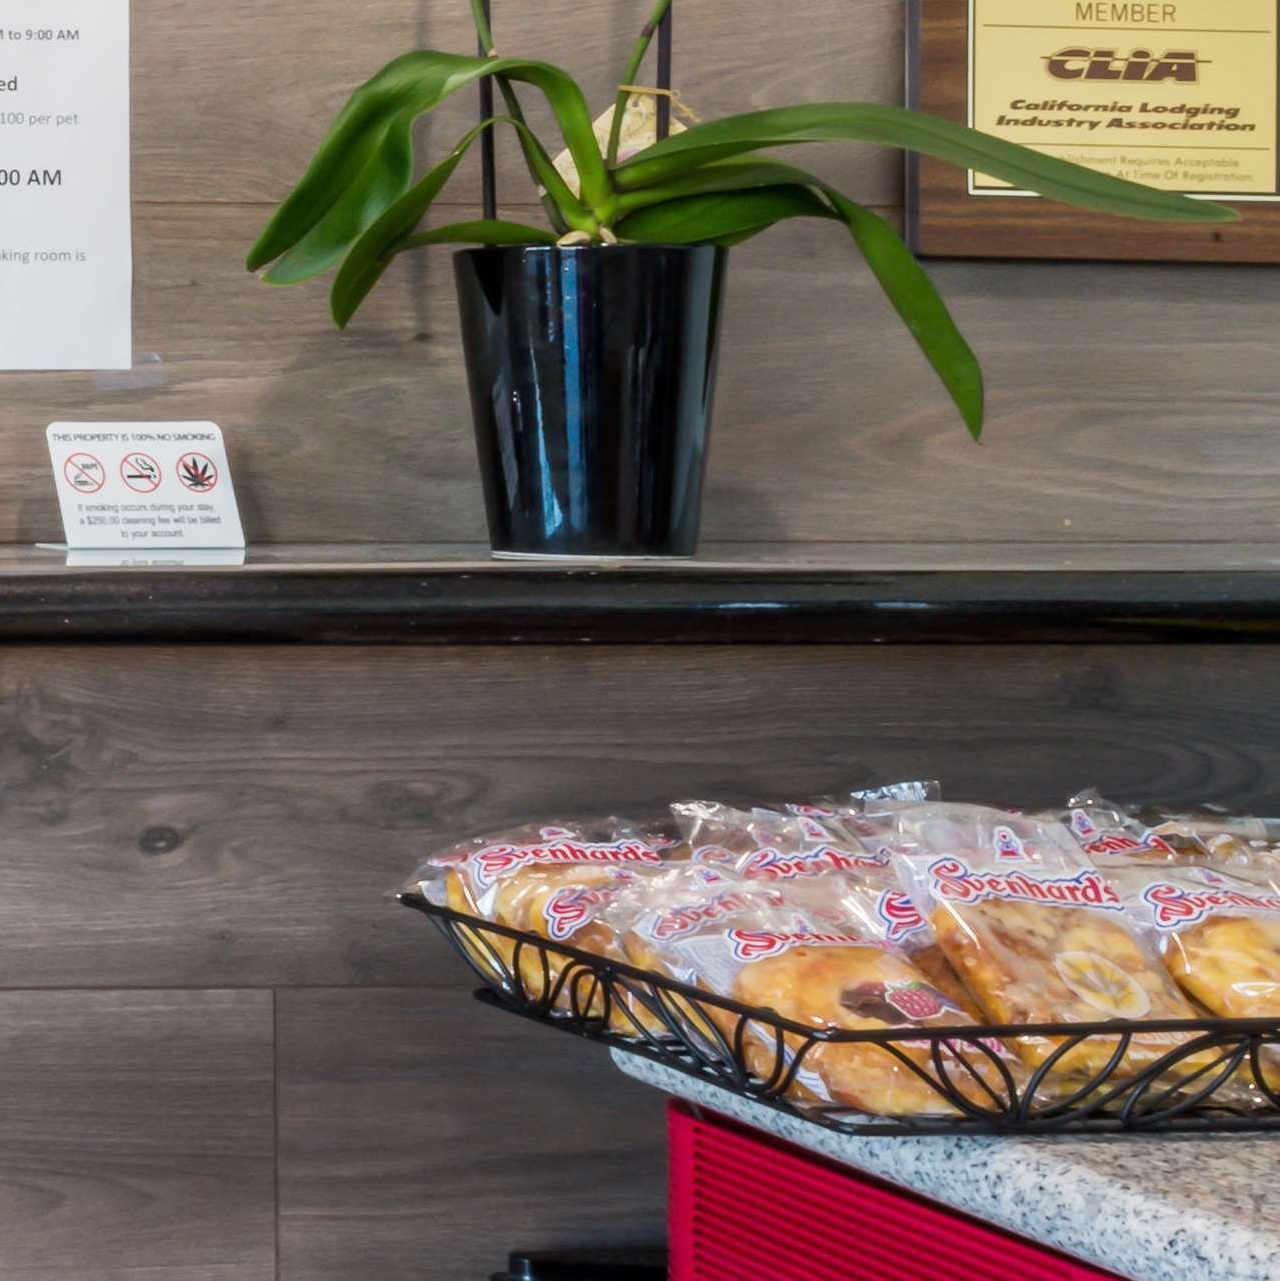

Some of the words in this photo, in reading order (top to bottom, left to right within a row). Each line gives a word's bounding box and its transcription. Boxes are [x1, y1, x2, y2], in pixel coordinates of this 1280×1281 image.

[1075, 2, 1177, 23] MEMBER
[7, 30, 22, 41] to
[24, 28, 54, 41] 9:00
[56, 29, 80, 41] AM
[1010, 99, 1133, 113] California
[1139, 102, 1241, 119] Lodging
[28, 114, 52, 128] per
[56, 113, 79, 128] pet
[995, 115, 1101, 131] Industry
[1105, 118, 1256, 132] Association
[1120, 156, 1170, 168] Requires
[1175, 157, 1240, 168] Acceptable
[26, 169, 62, 186] AM
[33, 251, 72, 262] room
[75, 249, 87, 262] is
[52, 433, 72, 442] THIS
[73, 433, 119, 442] PROPERTY
[131, 433, 156, 442] 100%
[157, 433, 172, 442] NO
[173, 433, 216, 442] SMOKING
[480, 843, 661, 879] Svenhard's
[933, 861, 1120, 904] Svenhard's
